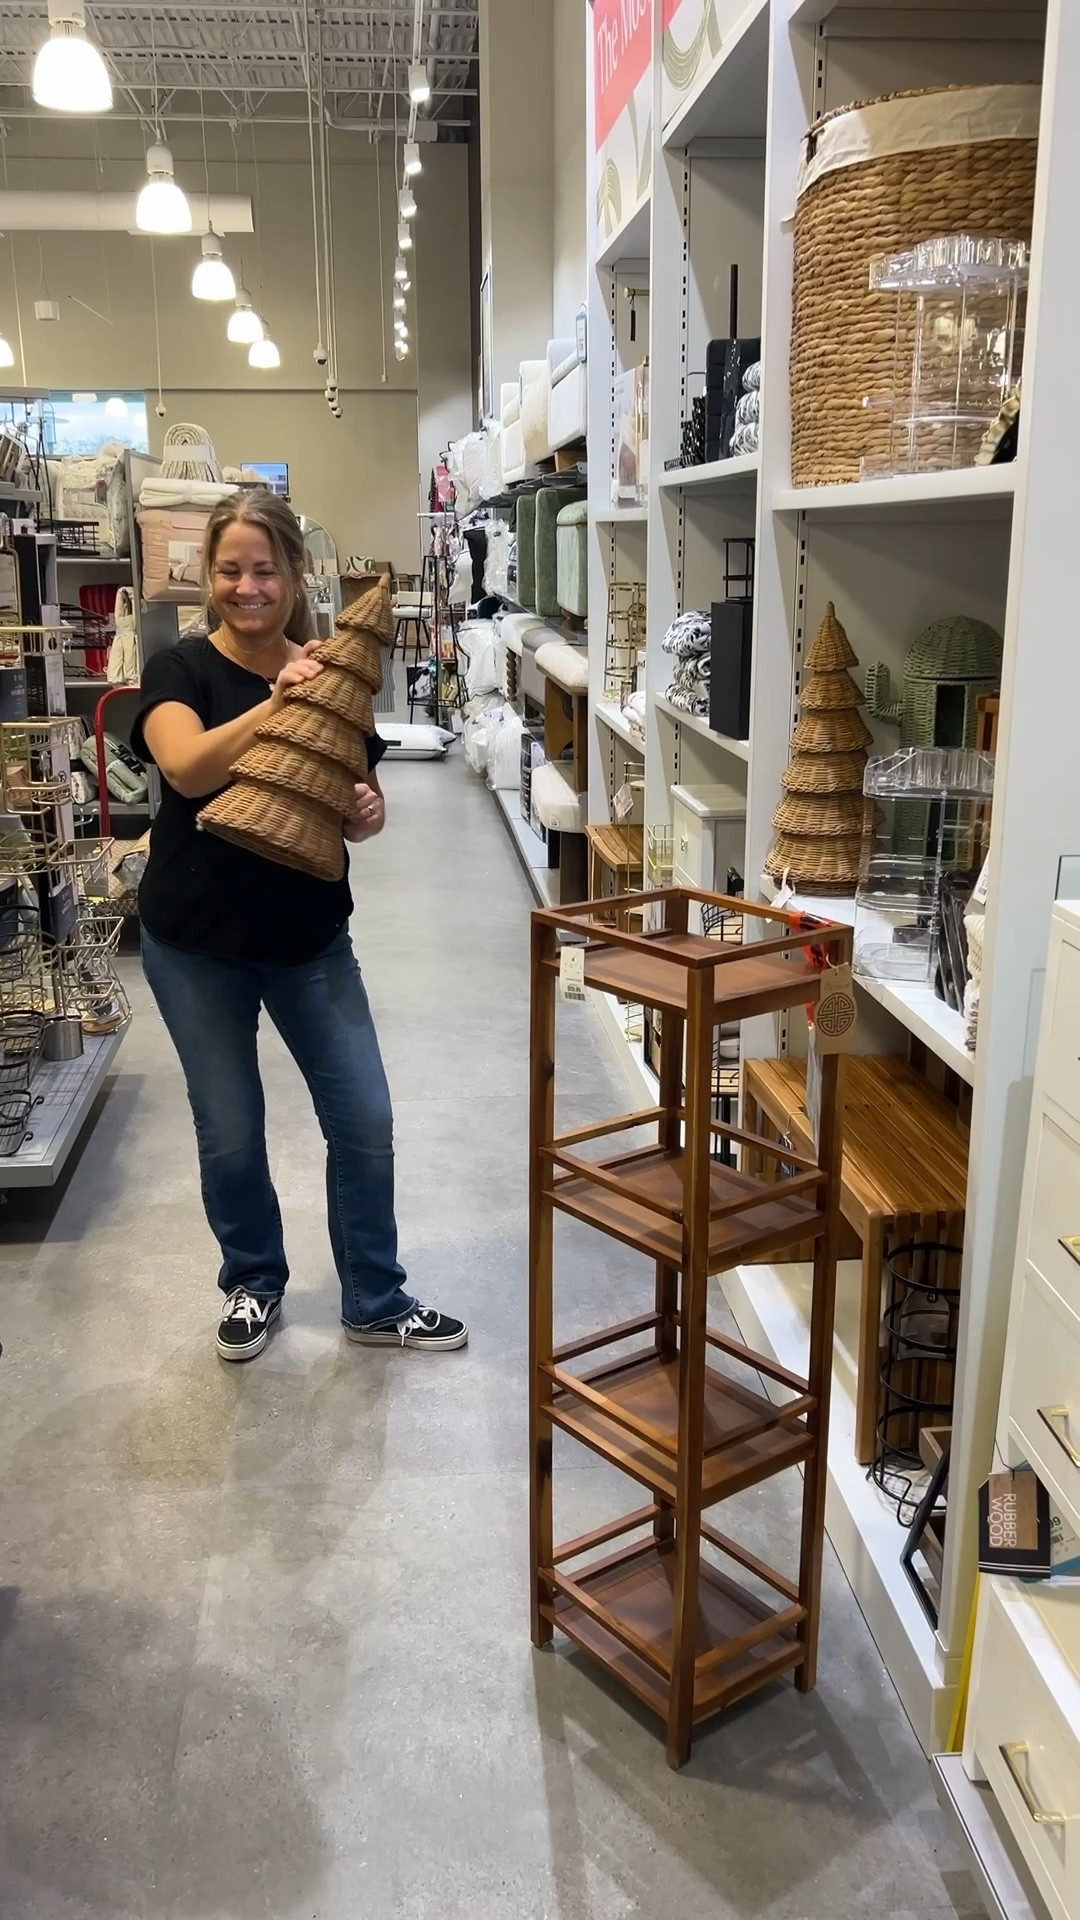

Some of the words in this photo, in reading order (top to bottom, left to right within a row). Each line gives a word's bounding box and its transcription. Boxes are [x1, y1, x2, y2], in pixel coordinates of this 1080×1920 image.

[597, 13, 618, 95] The
[620, 0, 651, 55] Mo
[989, 1497, 1004, 1546] WOOD
[1003, 1493, 1017, 1547] RUBBER
